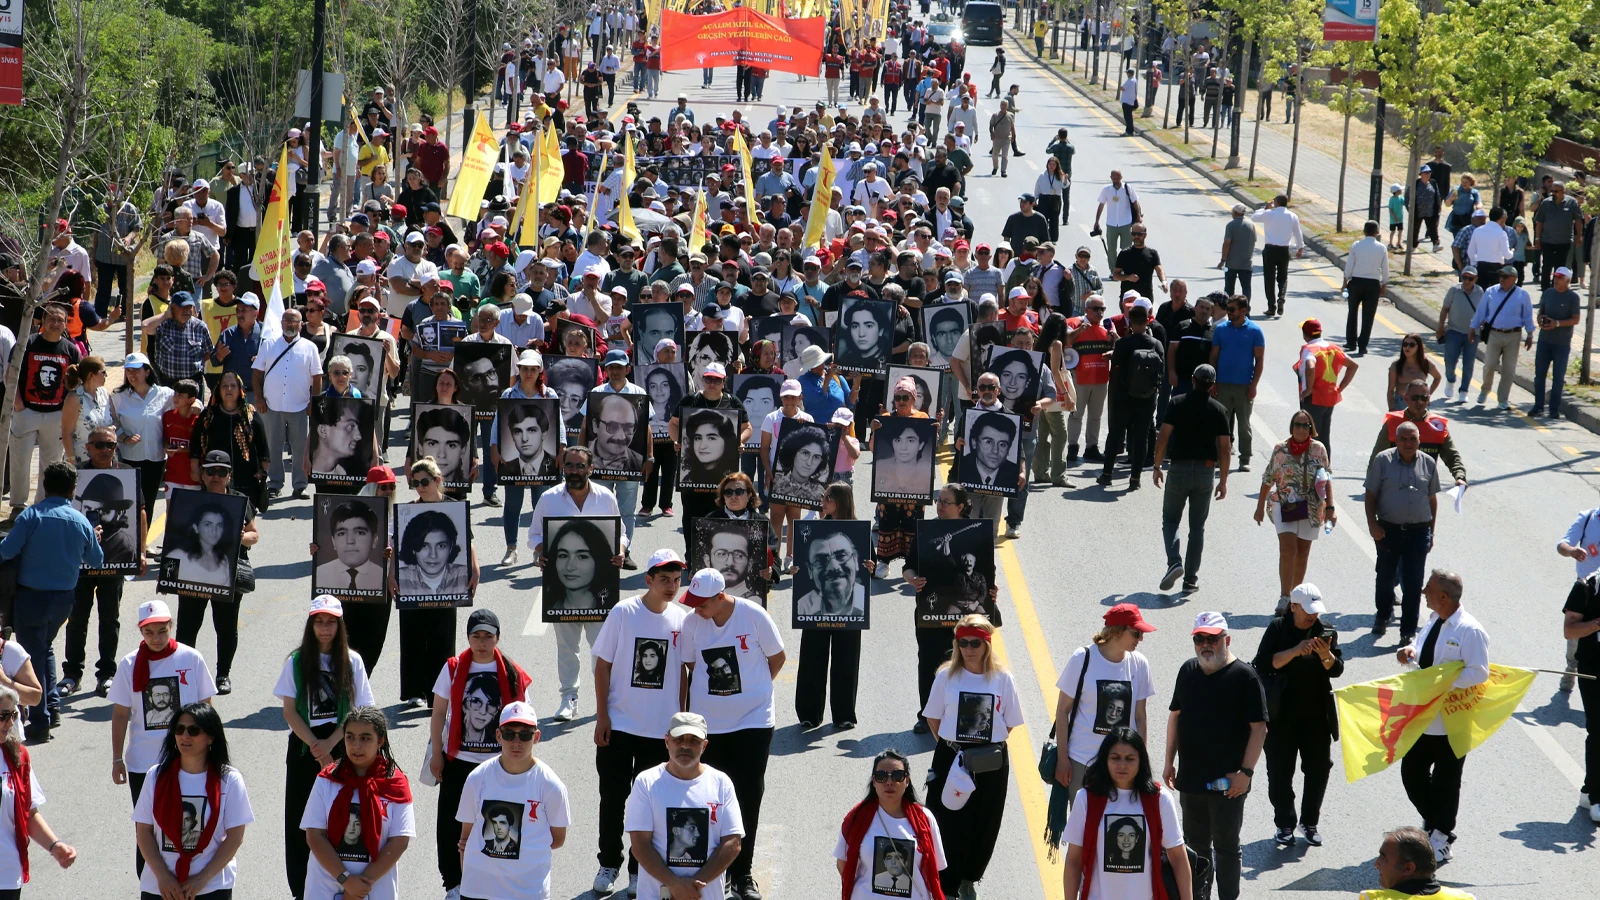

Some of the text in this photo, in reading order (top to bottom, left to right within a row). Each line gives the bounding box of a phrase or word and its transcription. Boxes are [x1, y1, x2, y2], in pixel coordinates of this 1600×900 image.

[702, 21, 732, 31] AÇALIM
[733, 20, 752, 28] KIZIL
[697, 30, 792, 43] GEÇSİN YEZİDLERİN ÇAĞI
[1, 55, 19, 65] SİVAS
[311, 473, 367, 482] ONURUMUZ
[593, 469, 643, 477] NURUMUZ
[960, 482, 1016, 493] ONURUMUZ
[874, 492, 931, 500] ONURUMUZ
[79, 562, 137, 570] NUUMUZ
[159, 580, 230, 596] ONURUMUZ
[316, 587, 383, 597] ONURUMUZ
[400, 594, 469, 602] ONURUMUZ
[922, 613, 991, 621] ONURUZ
